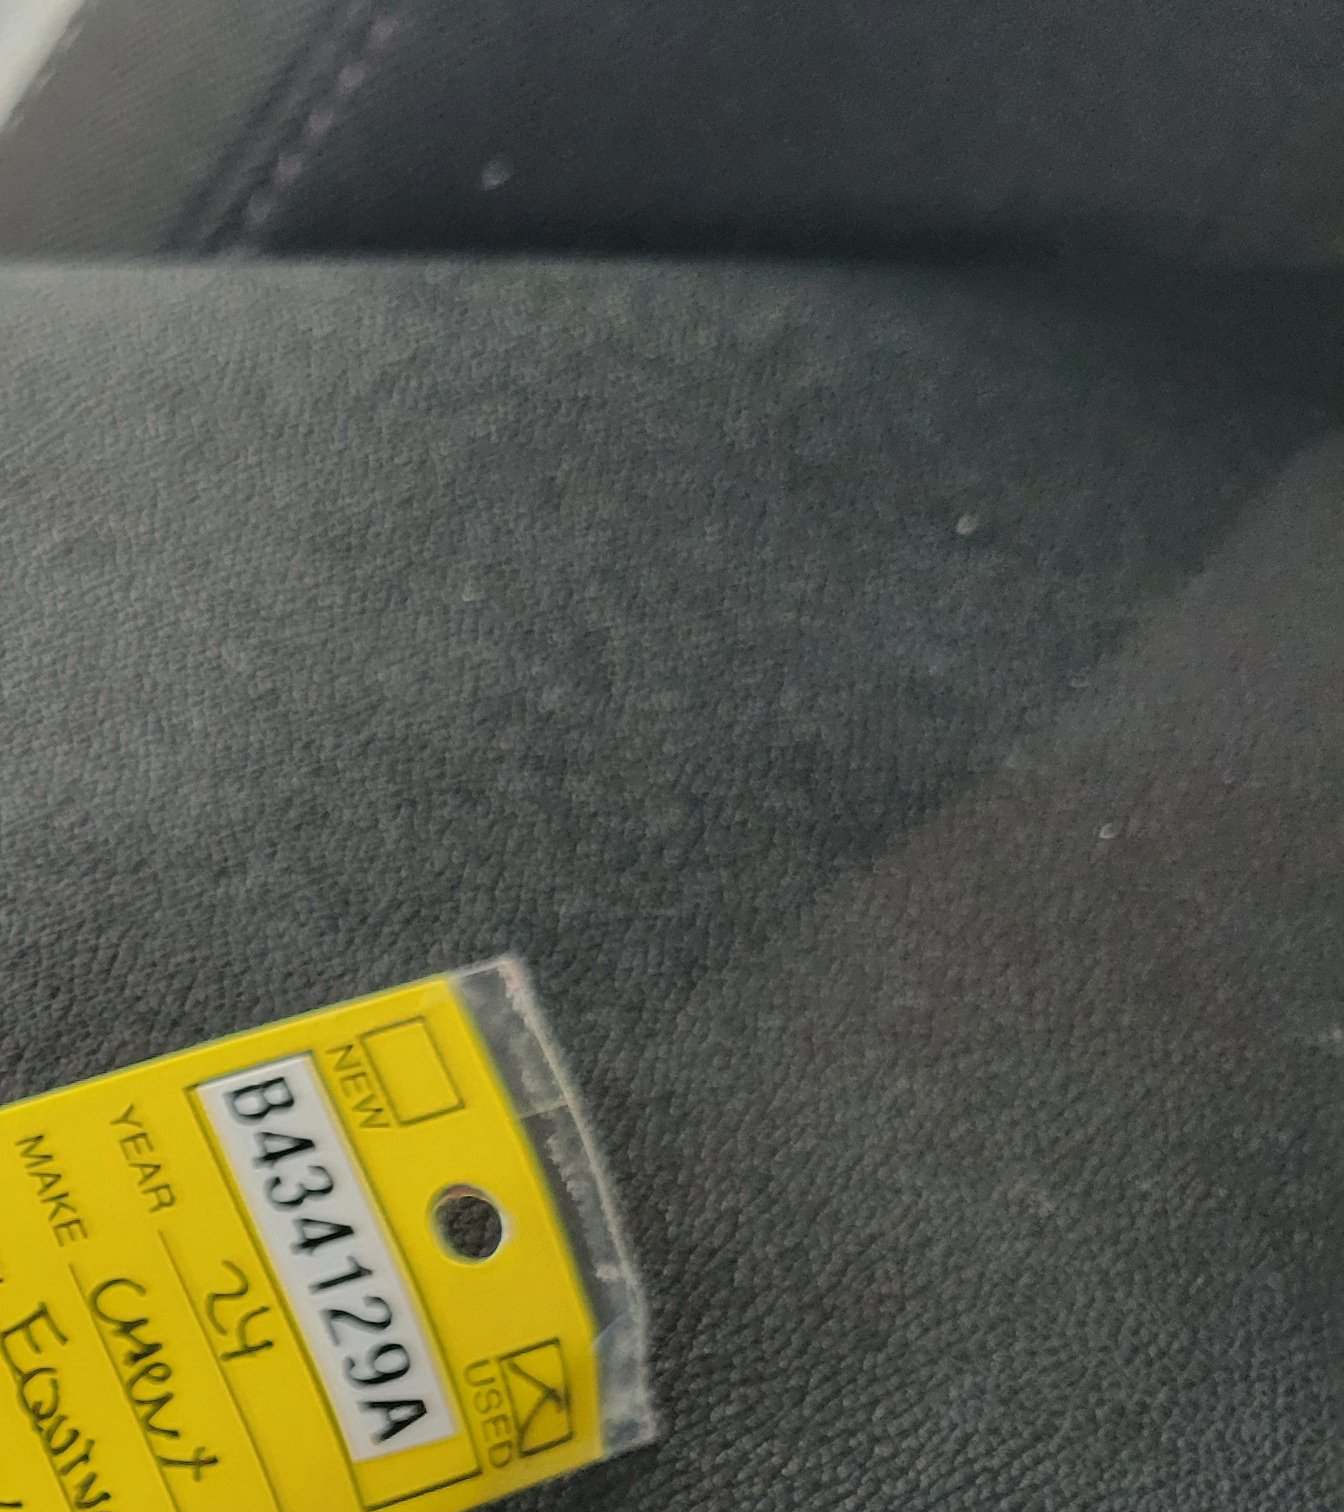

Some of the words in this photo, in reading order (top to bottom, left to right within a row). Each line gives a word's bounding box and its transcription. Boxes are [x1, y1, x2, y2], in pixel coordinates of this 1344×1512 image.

[326, 1043, 390, 1129] NEW
[15, 1134, 89, 1247] MAKE
[110, 1104, 175, 1213] YEAR
[206, 1260, 274, 1362] 24
[225, 1076, 428, 1446] B434129A
[464, 1359, 513, 1468] USED
